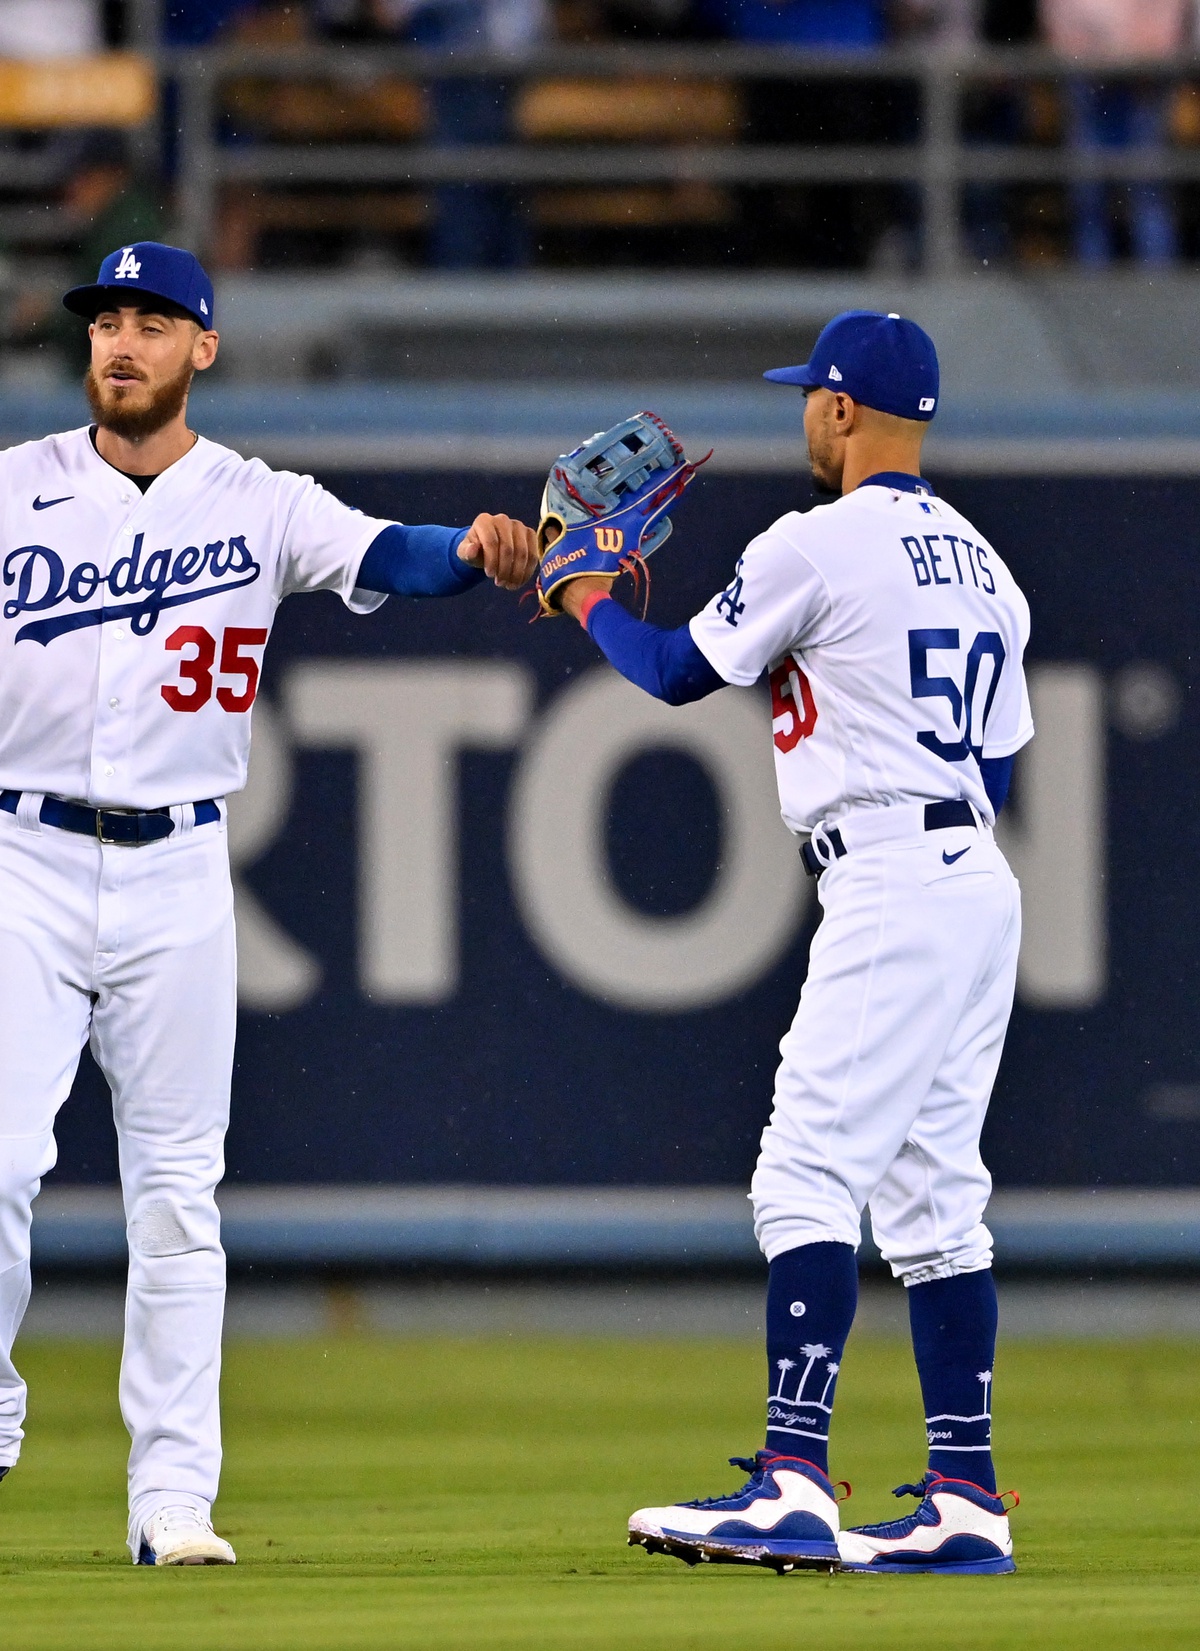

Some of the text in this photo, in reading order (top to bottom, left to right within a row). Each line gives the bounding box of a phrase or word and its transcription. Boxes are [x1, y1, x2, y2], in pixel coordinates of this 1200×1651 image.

[115, 248, 141, 279] LA
[594, 526, 624, 553] W
[3, 532, 261, 636] Dodgers
[542, 548, 587, 578] Wilson
[901, 534, 996, 595] BETTS
[161, 625, 268, 713] 35
[908, 628, 1006, 766] 50
[768, 1405, 817, 1426] Dodgers
